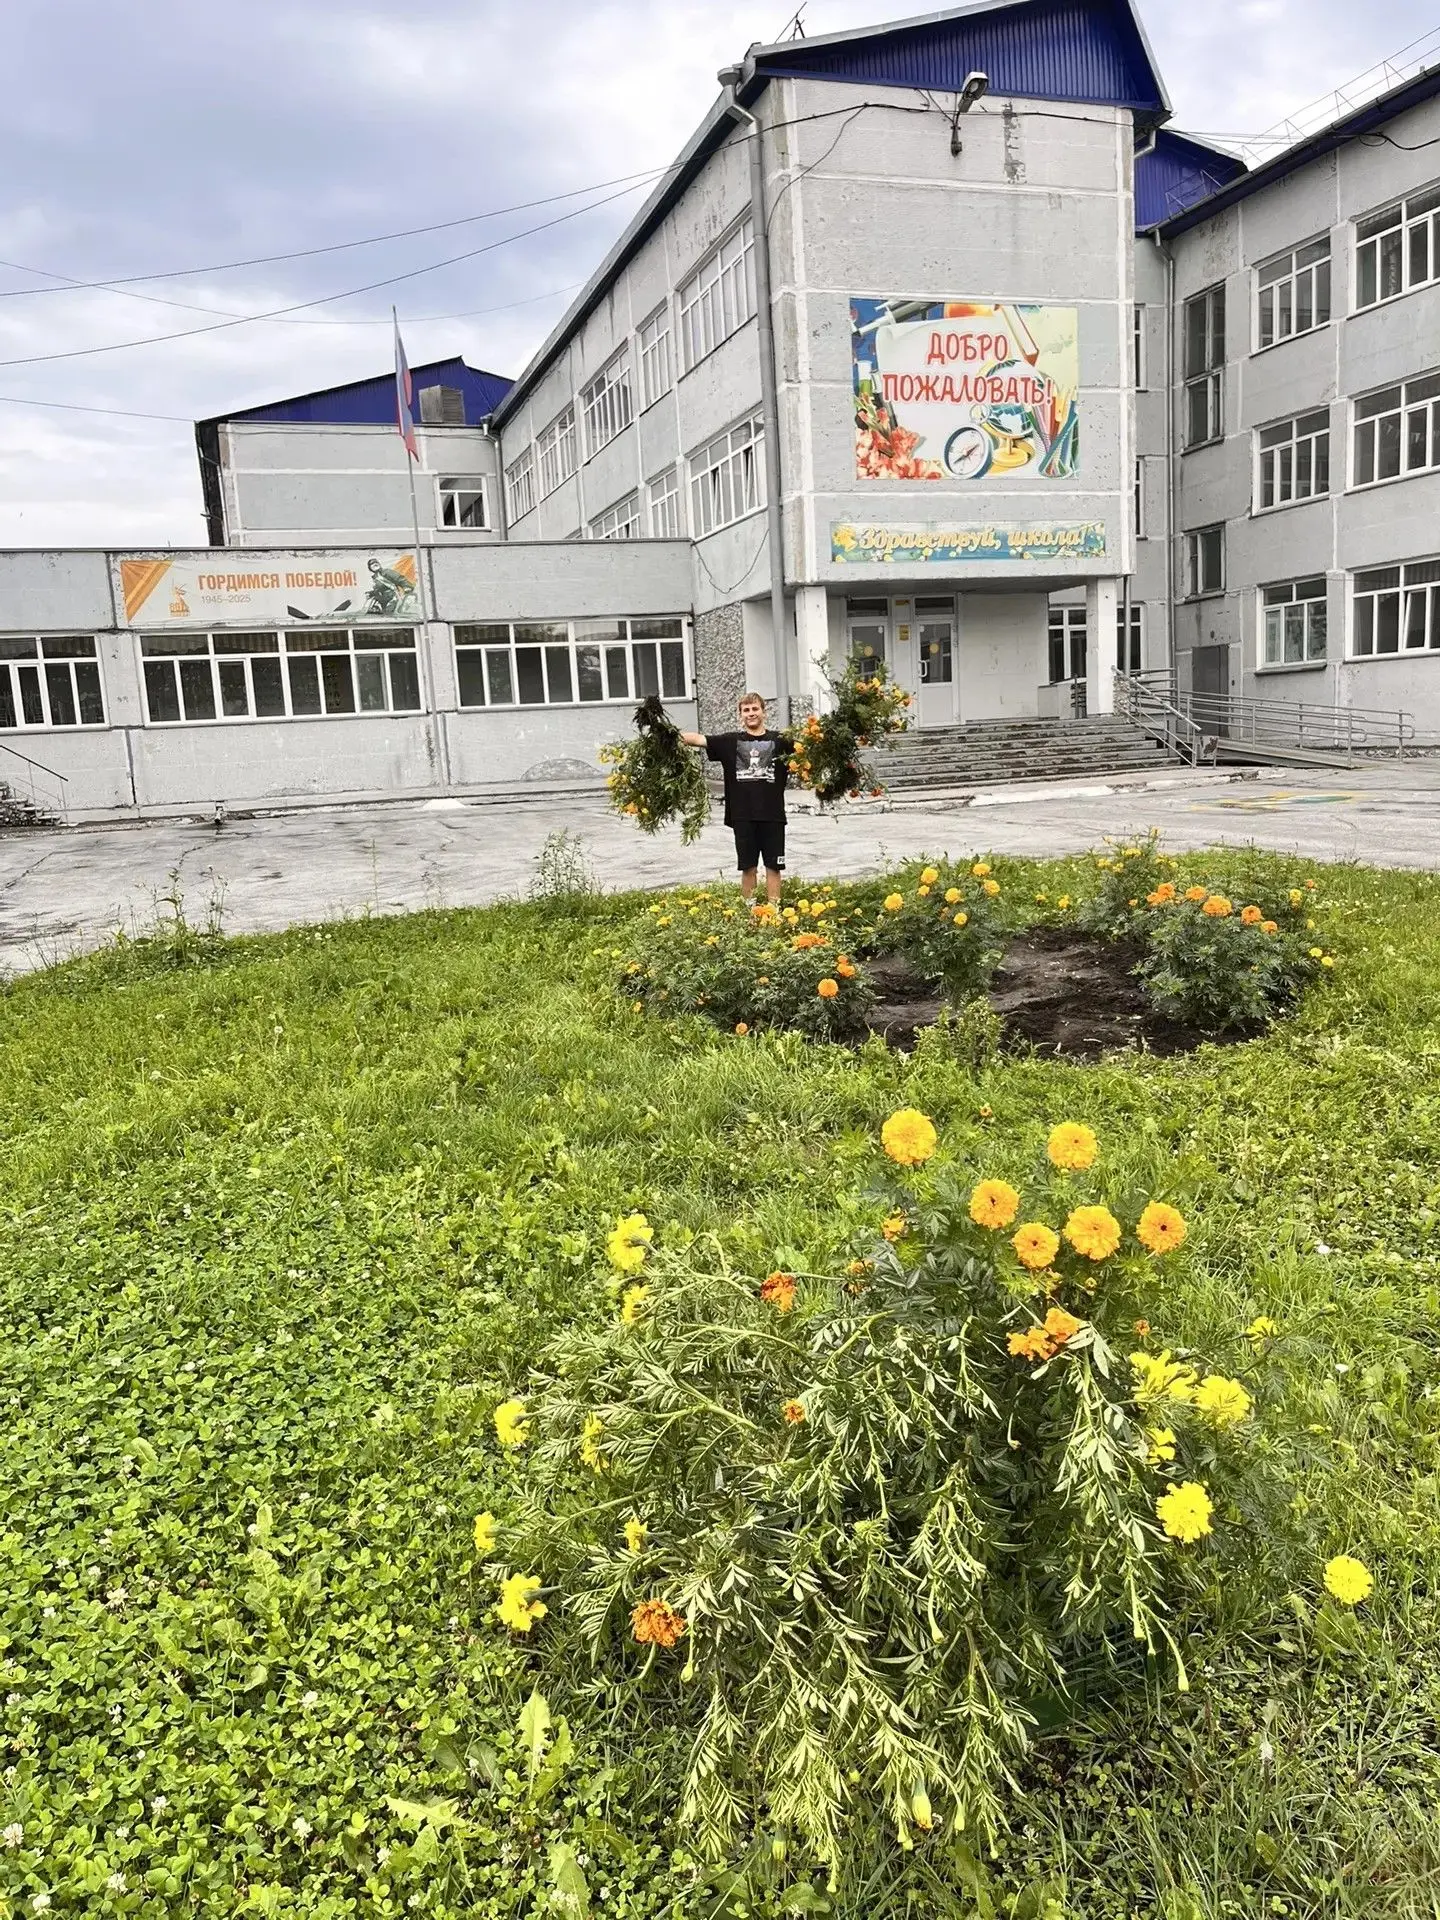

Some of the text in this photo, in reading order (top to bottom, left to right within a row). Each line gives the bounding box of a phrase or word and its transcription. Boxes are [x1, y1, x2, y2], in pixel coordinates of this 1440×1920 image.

[927, 332, 1007, 365] ДОБРО
[882, 374, 1052, 405] ПОЖАЛОВАТЬ!
[859, 527, 1087, 552] Здравствуй, школа!
[198, 570, 357, 591] ГОРДИМСЯ ПОБЕДОЙ!
